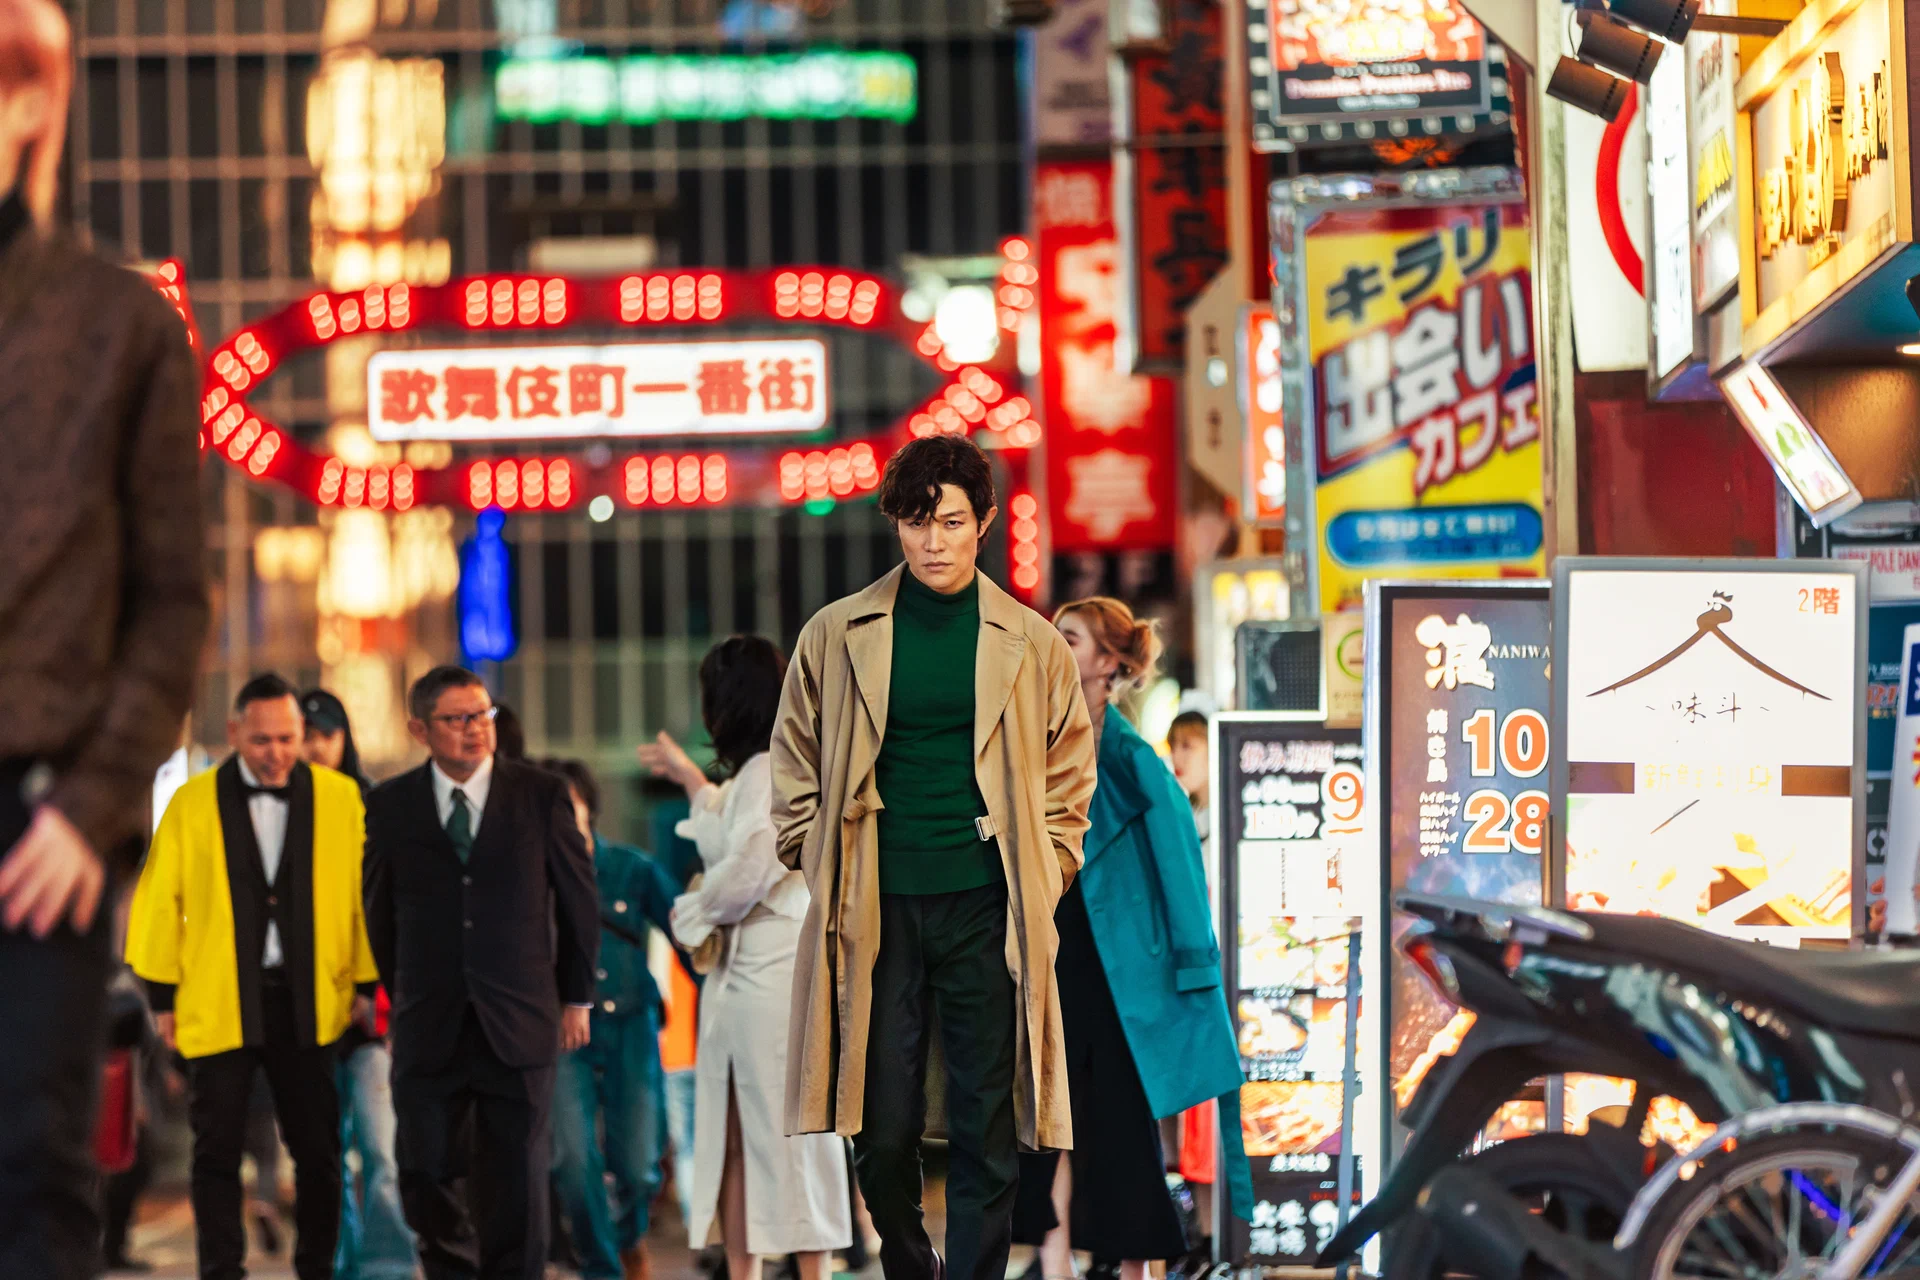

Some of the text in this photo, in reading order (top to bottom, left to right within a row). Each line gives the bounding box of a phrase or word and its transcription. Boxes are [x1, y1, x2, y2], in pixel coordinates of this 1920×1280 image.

[1326, 208, 1500, 322] キラリ
[380, 358, 817, 421] 歌舞伎町一番街
[1324, 277, 1530, 460] 出会い
[1412, 386, 1538, 490] カフェ
[1798, 588, 1840, 614] 2階
